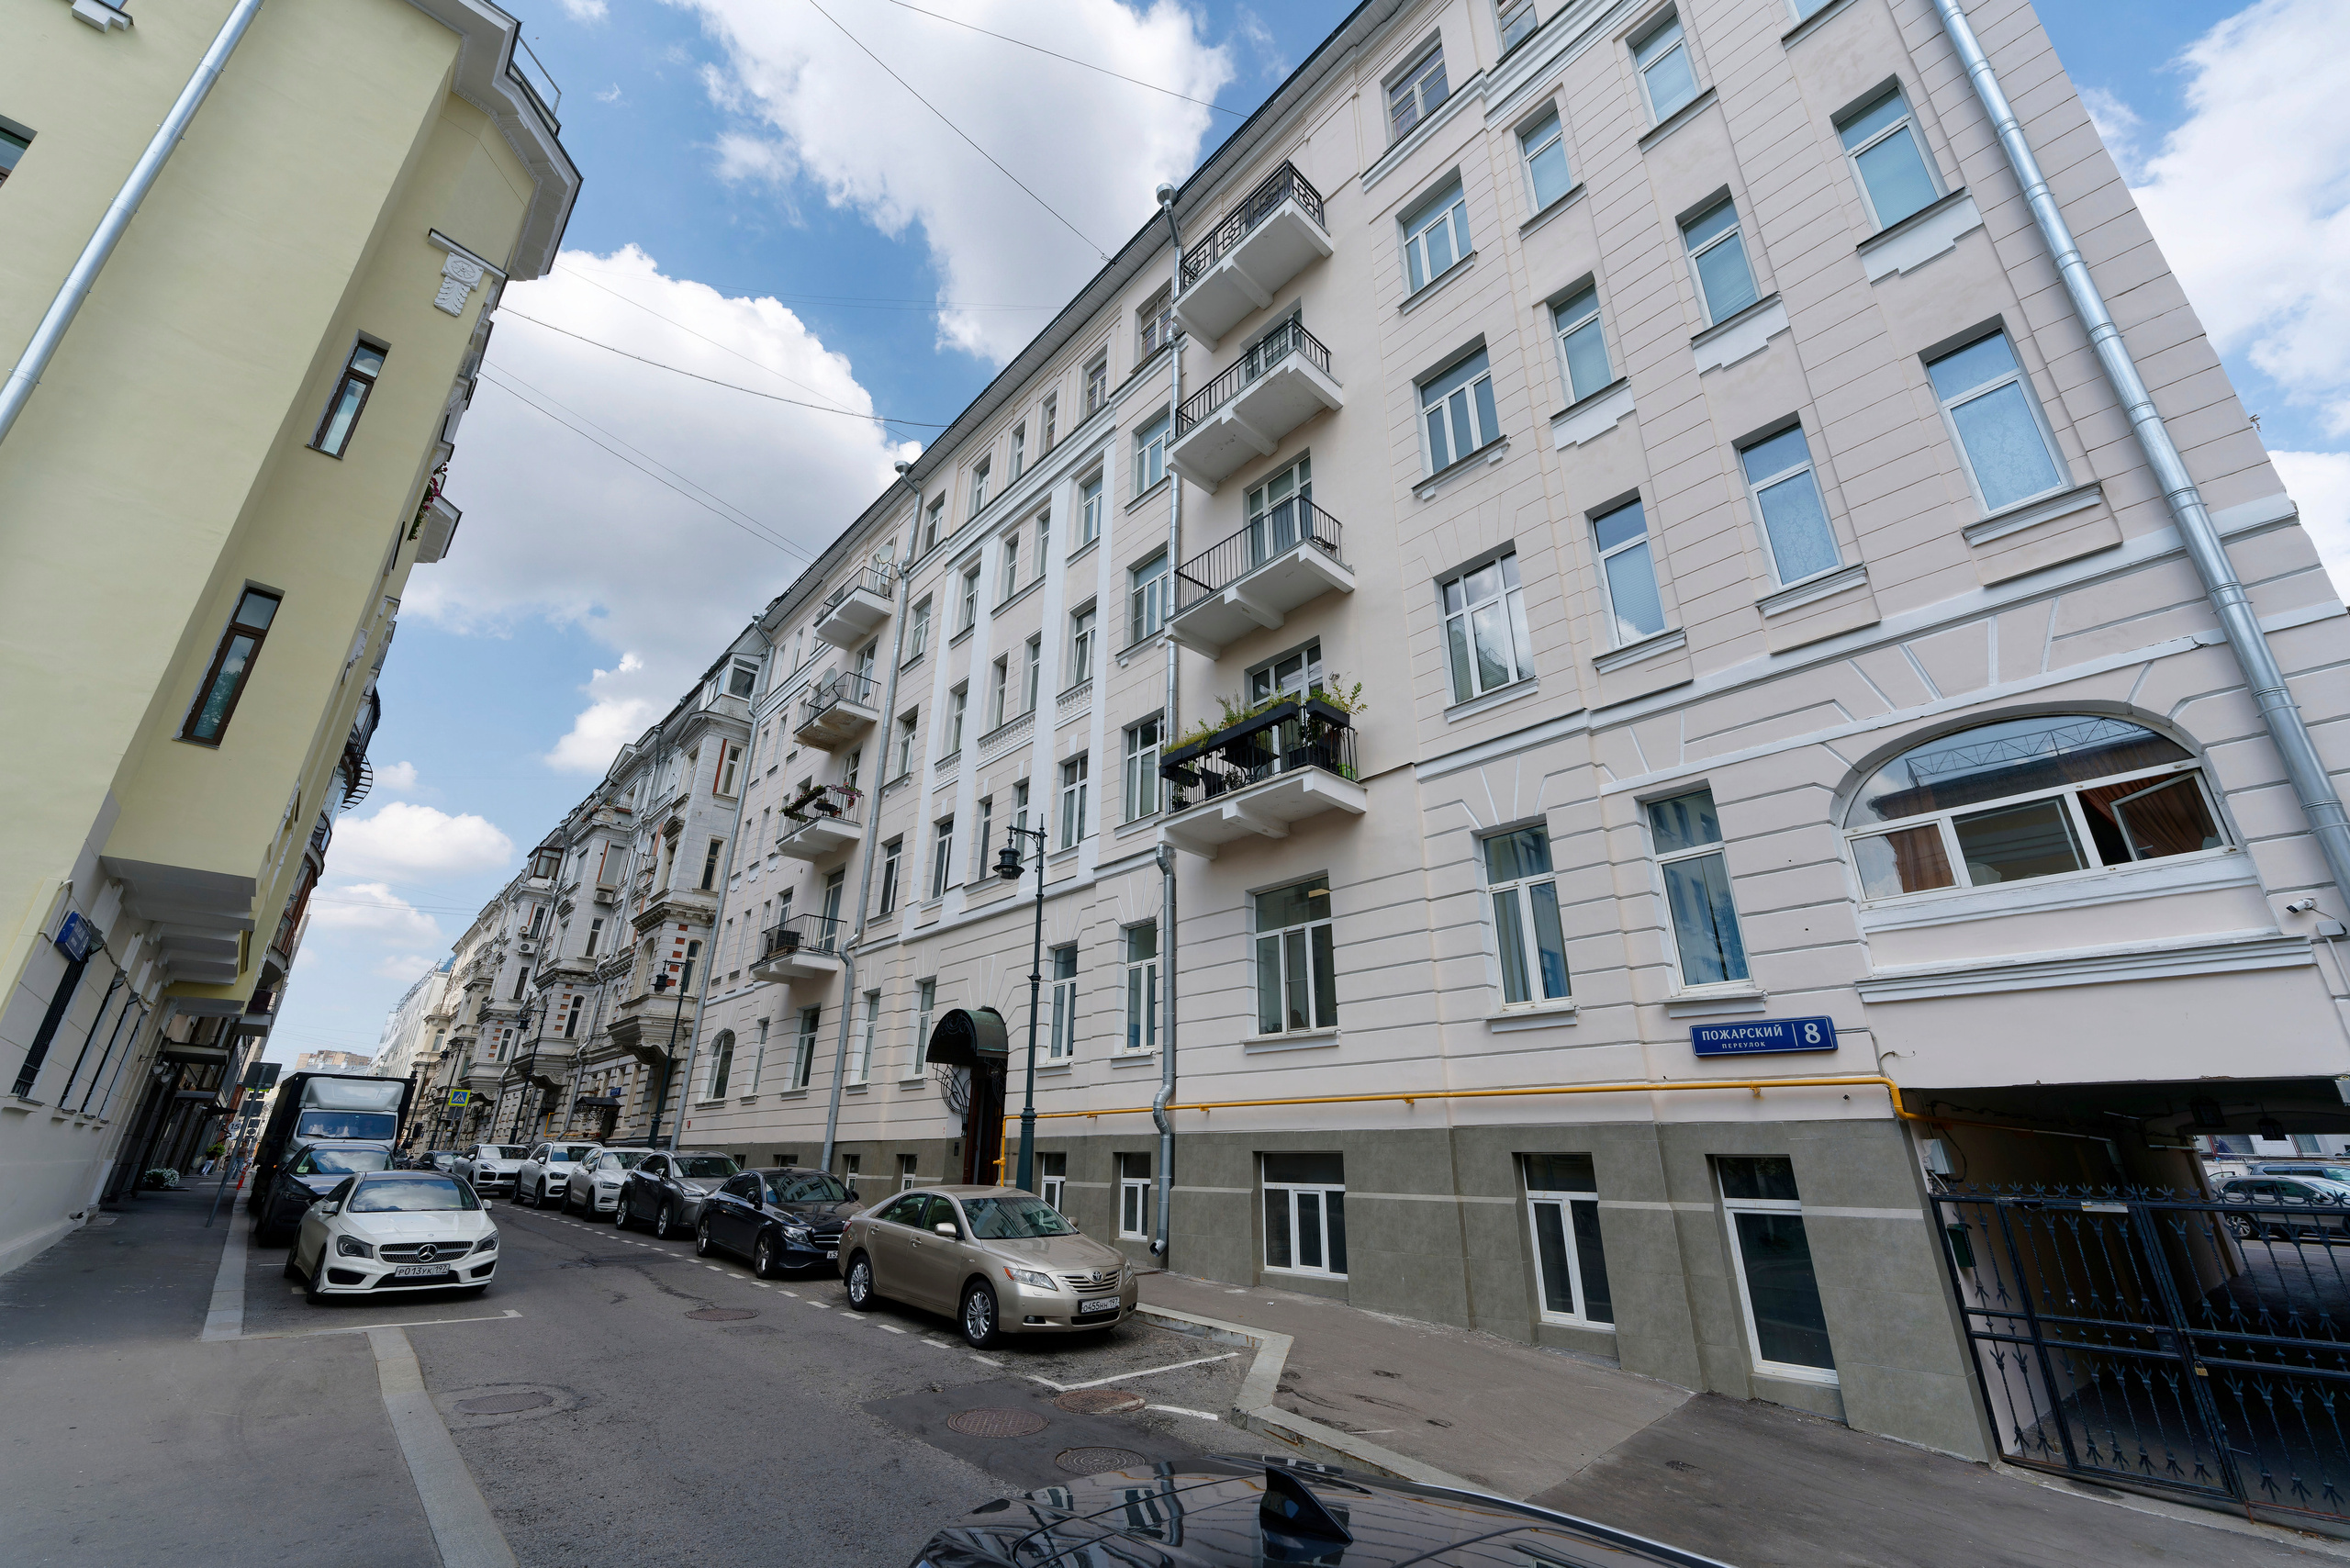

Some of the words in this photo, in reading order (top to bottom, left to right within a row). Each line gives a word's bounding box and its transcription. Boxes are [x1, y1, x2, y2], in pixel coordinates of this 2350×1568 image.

[1701, 1024, 1784, 1041] ПОЖАРСКИЙ
[1804, 1023, 1821, 1044] 8
[1721, 1041, 1766, 1049] ПЕРЕУЛОК
